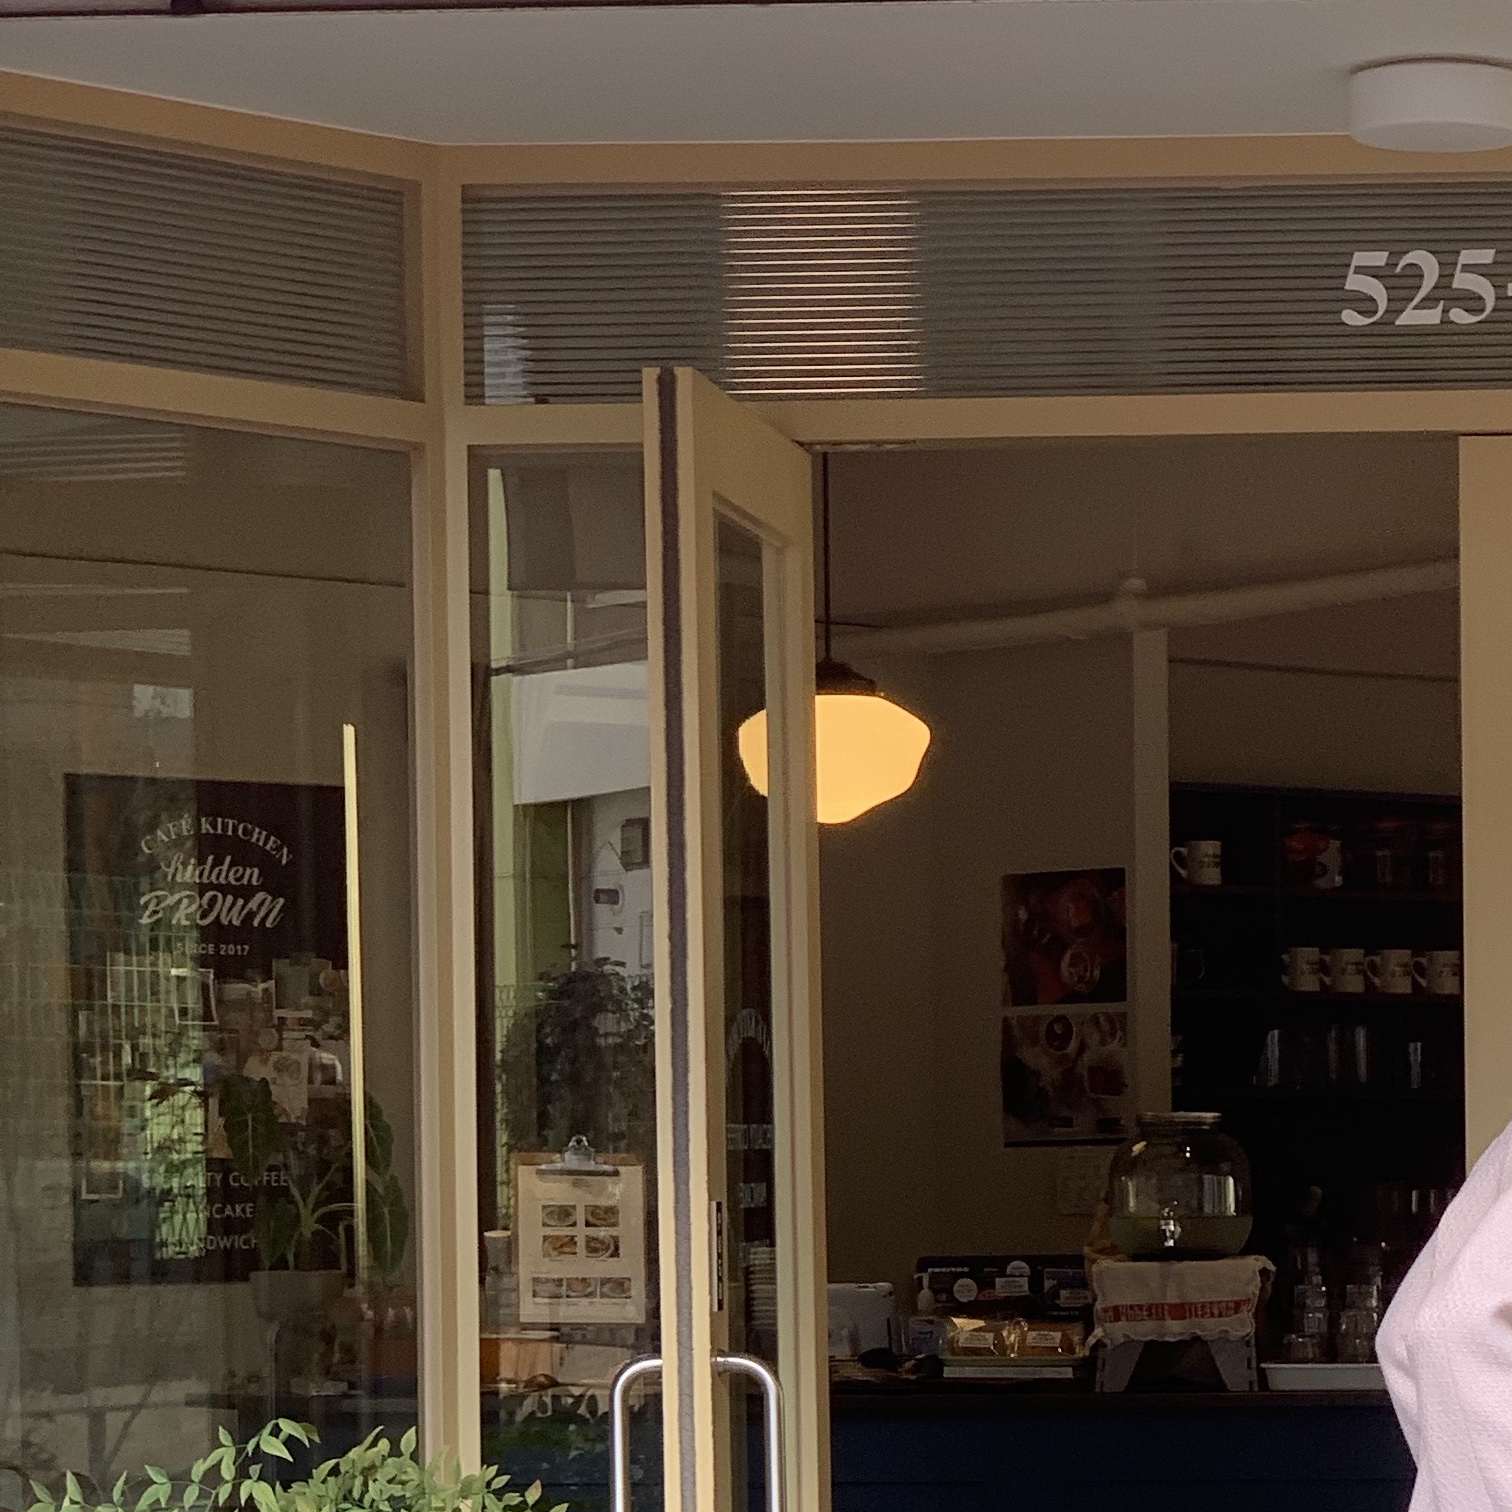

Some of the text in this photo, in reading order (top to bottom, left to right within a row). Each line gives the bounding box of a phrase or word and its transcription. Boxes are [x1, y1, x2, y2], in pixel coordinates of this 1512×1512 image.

[140, 813, 294, 866] CAFÉ KITCHEN
[160, 852, 263, 886] hidden
[138, 890, 286, 928] BROWN
[219, 943, 250, 956] 2017
